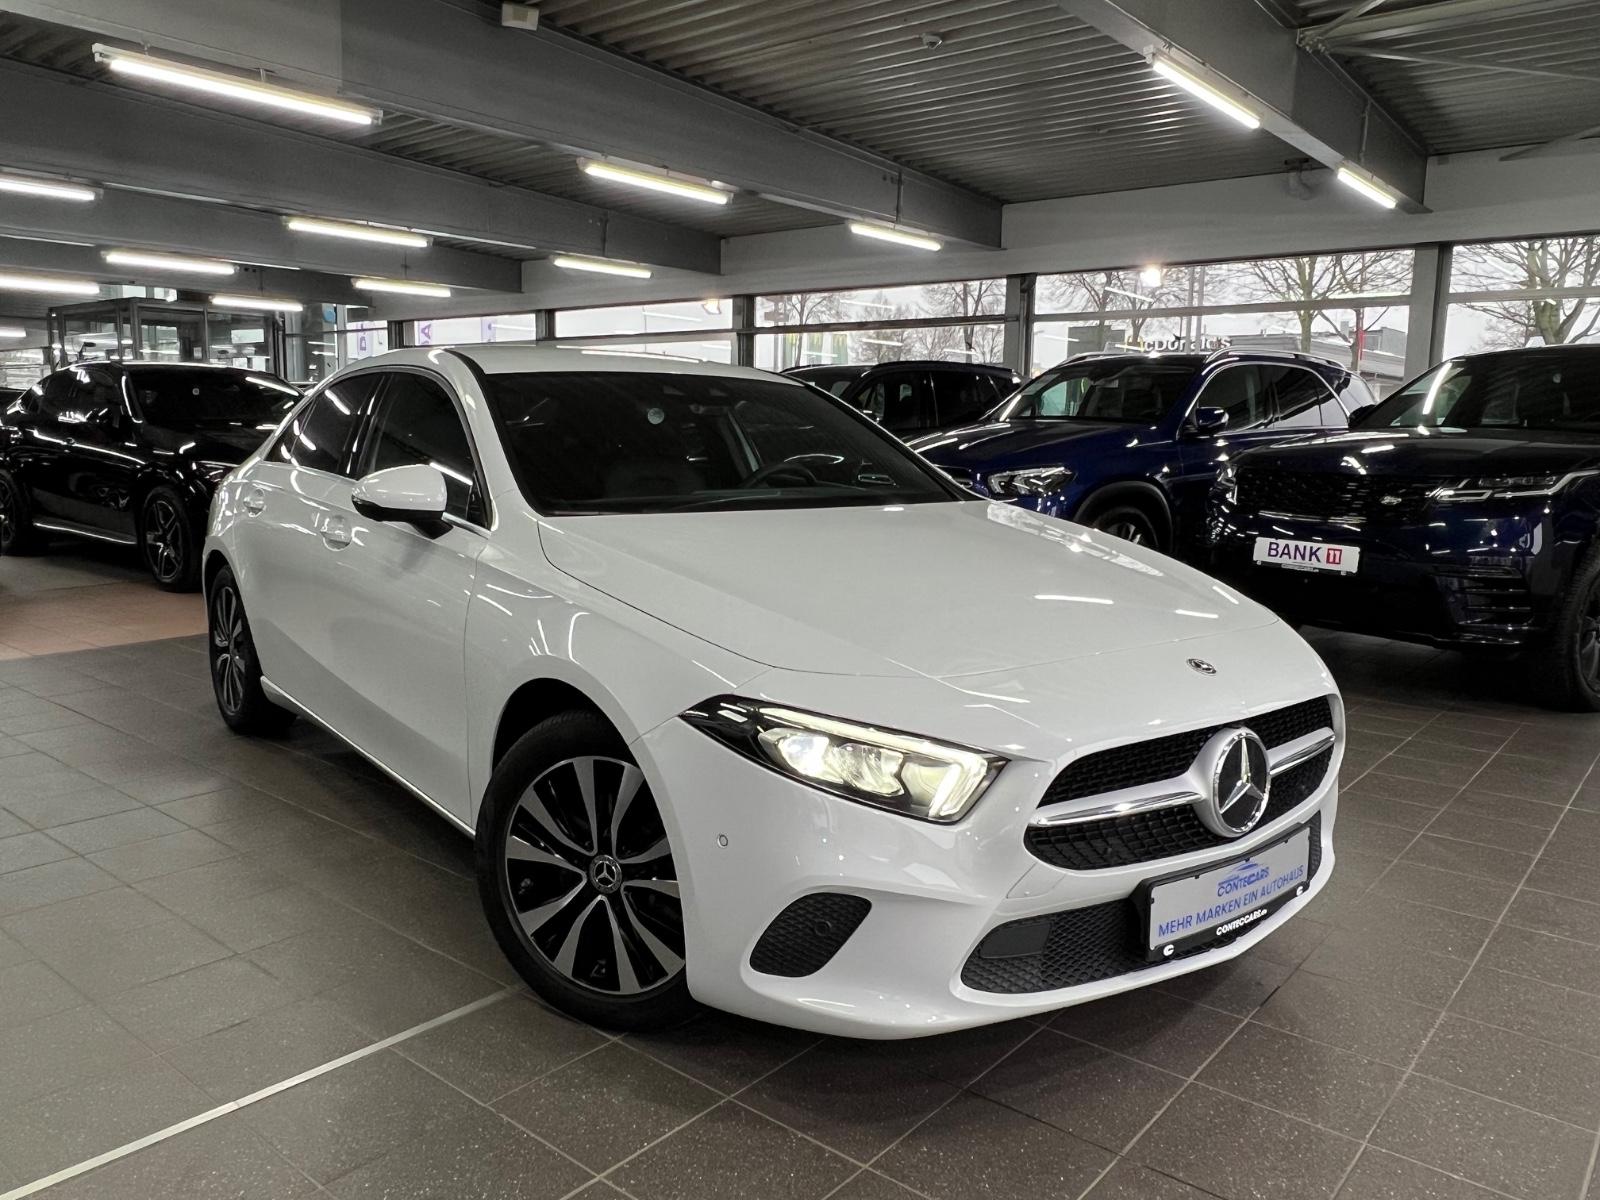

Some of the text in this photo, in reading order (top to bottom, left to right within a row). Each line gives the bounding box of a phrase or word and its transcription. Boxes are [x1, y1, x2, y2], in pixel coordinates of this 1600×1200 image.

[1268, 542, 1322, 563] BANK
[1158, 864, 1304, 937] MEHR MARKEN EIN AUTOHAUS
